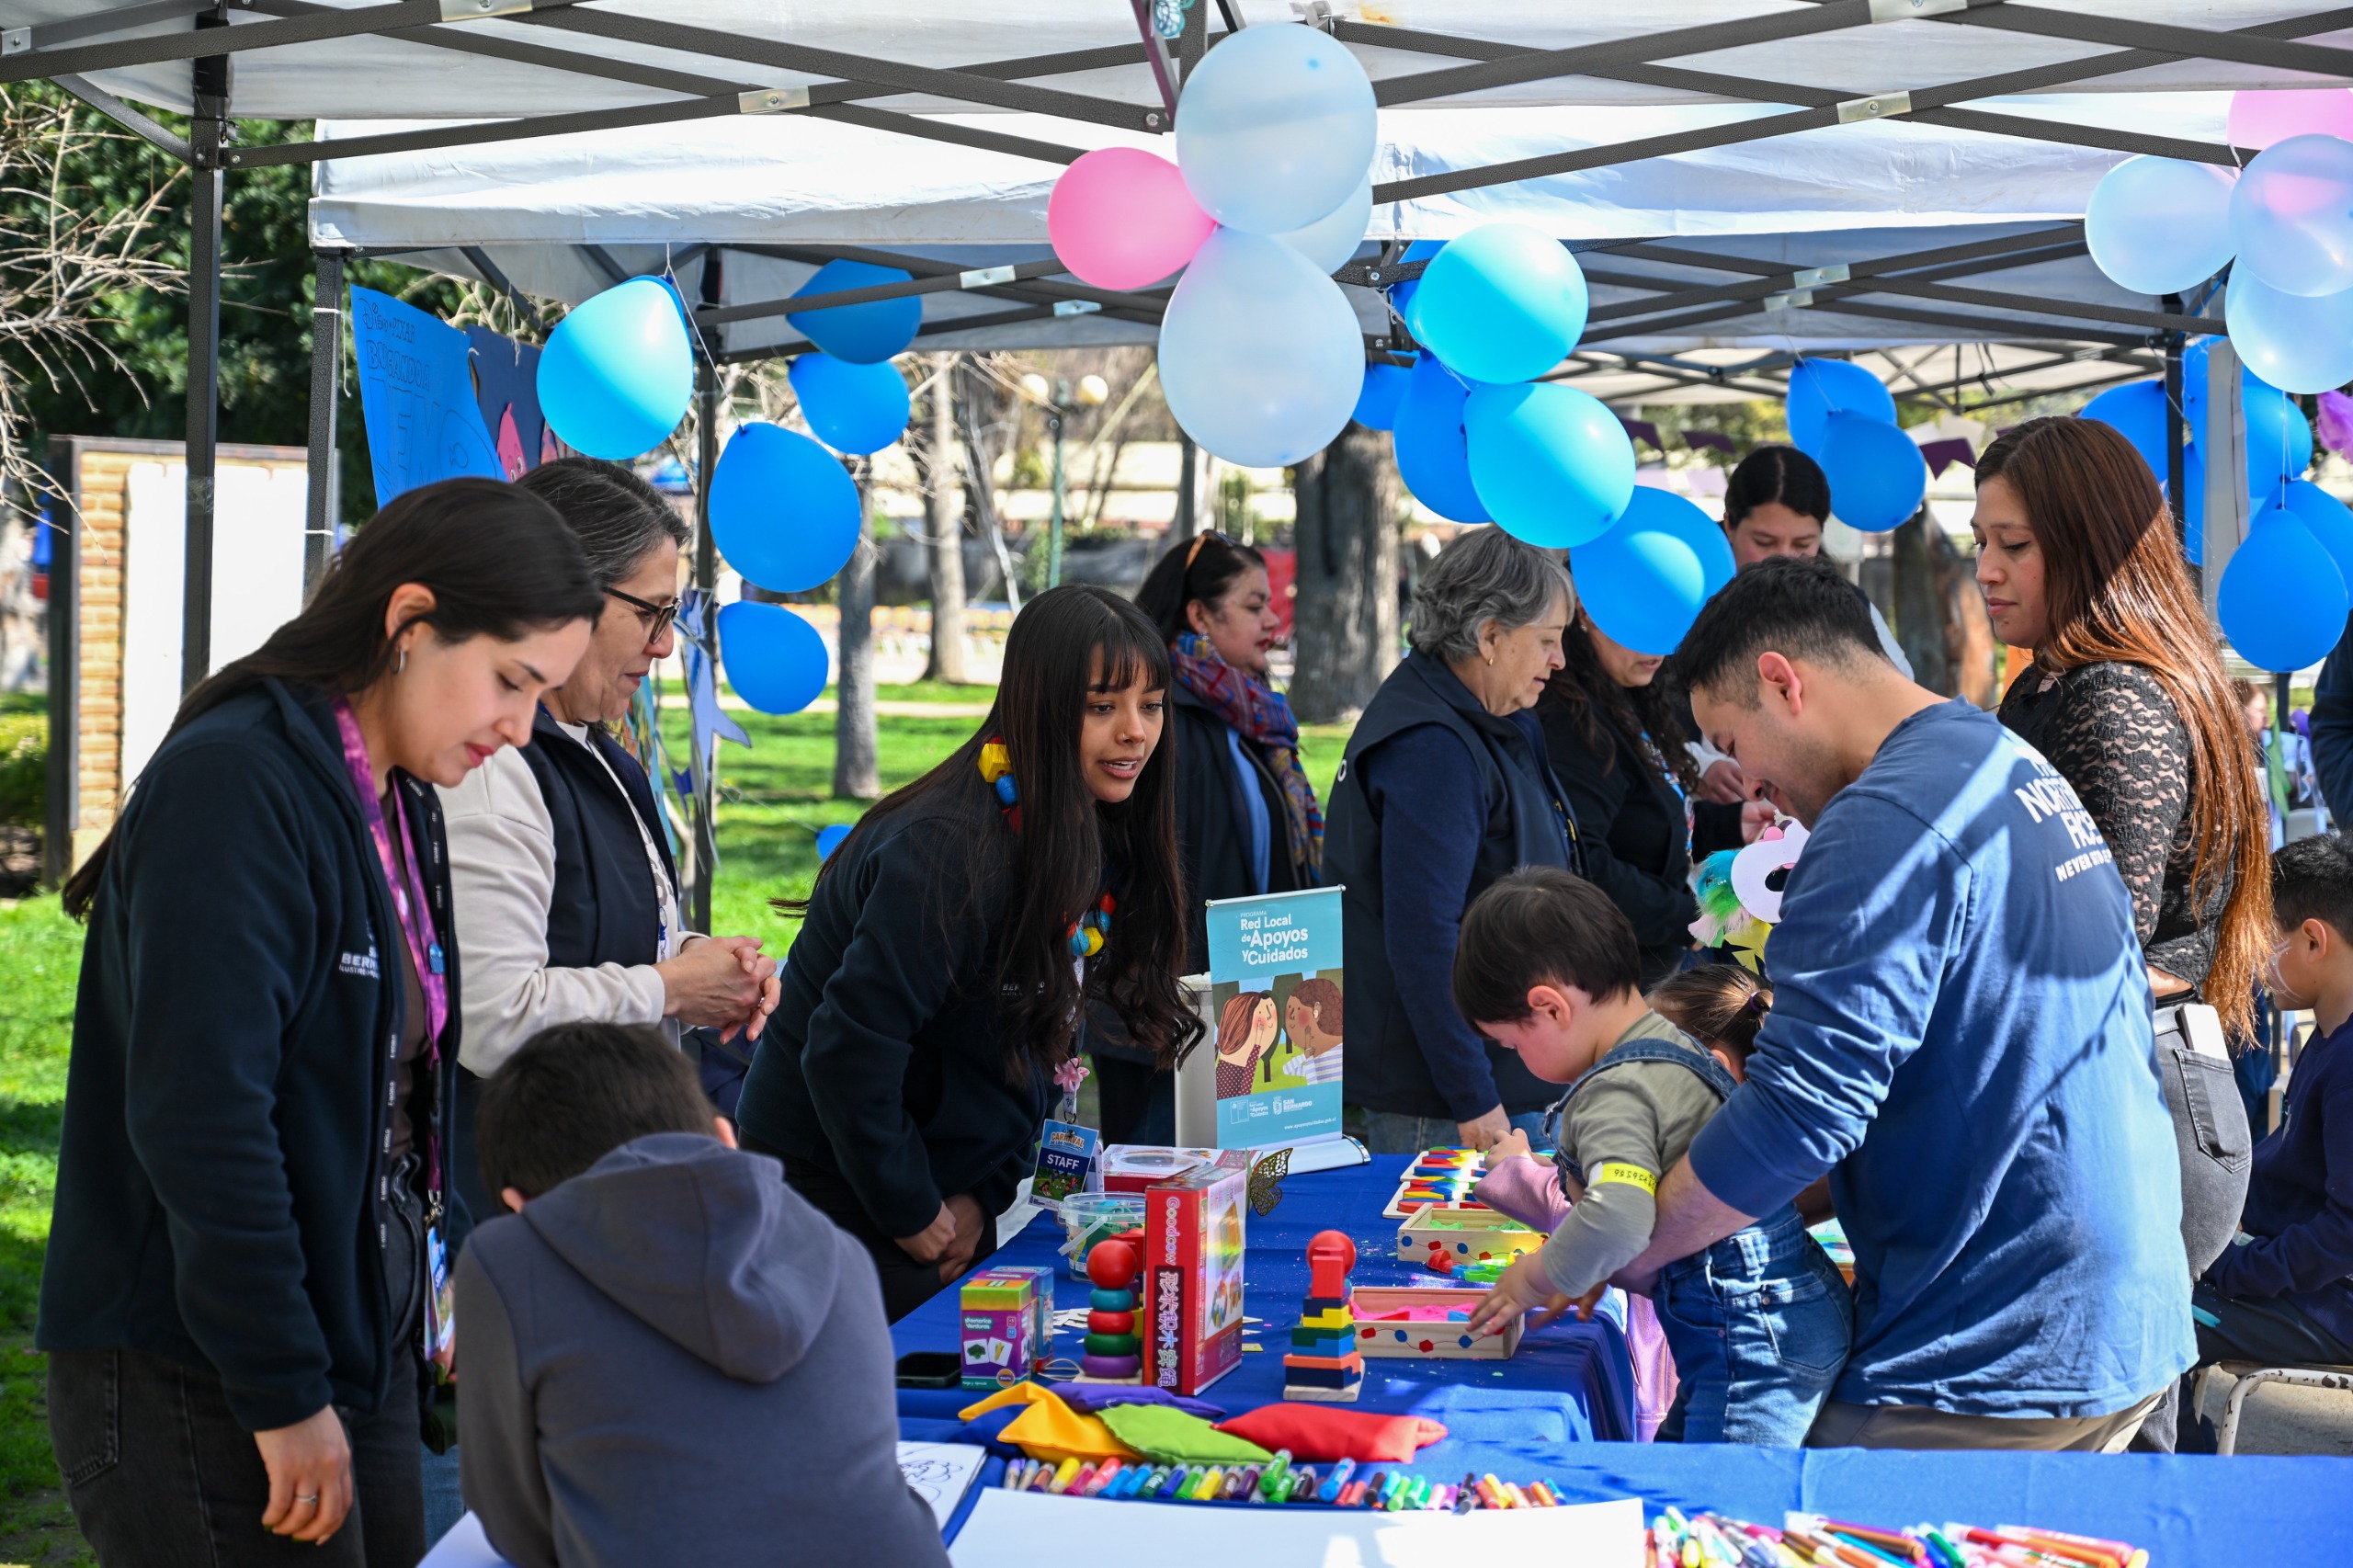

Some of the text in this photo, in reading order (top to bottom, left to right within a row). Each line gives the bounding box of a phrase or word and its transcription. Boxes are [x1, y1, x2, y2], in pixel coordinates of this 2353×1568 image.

[2055, 853, 2093, 882] NEVER
[1240, 910, 1267, 918] PROGRAMA
[1240, 914, 1291, 931] Red Local
[1241, 928, 1309, 950] de Apoyos
[1247, 946, 1309, 965] Cuidados
[1047, 1153, 1080, 1170] STAFF
